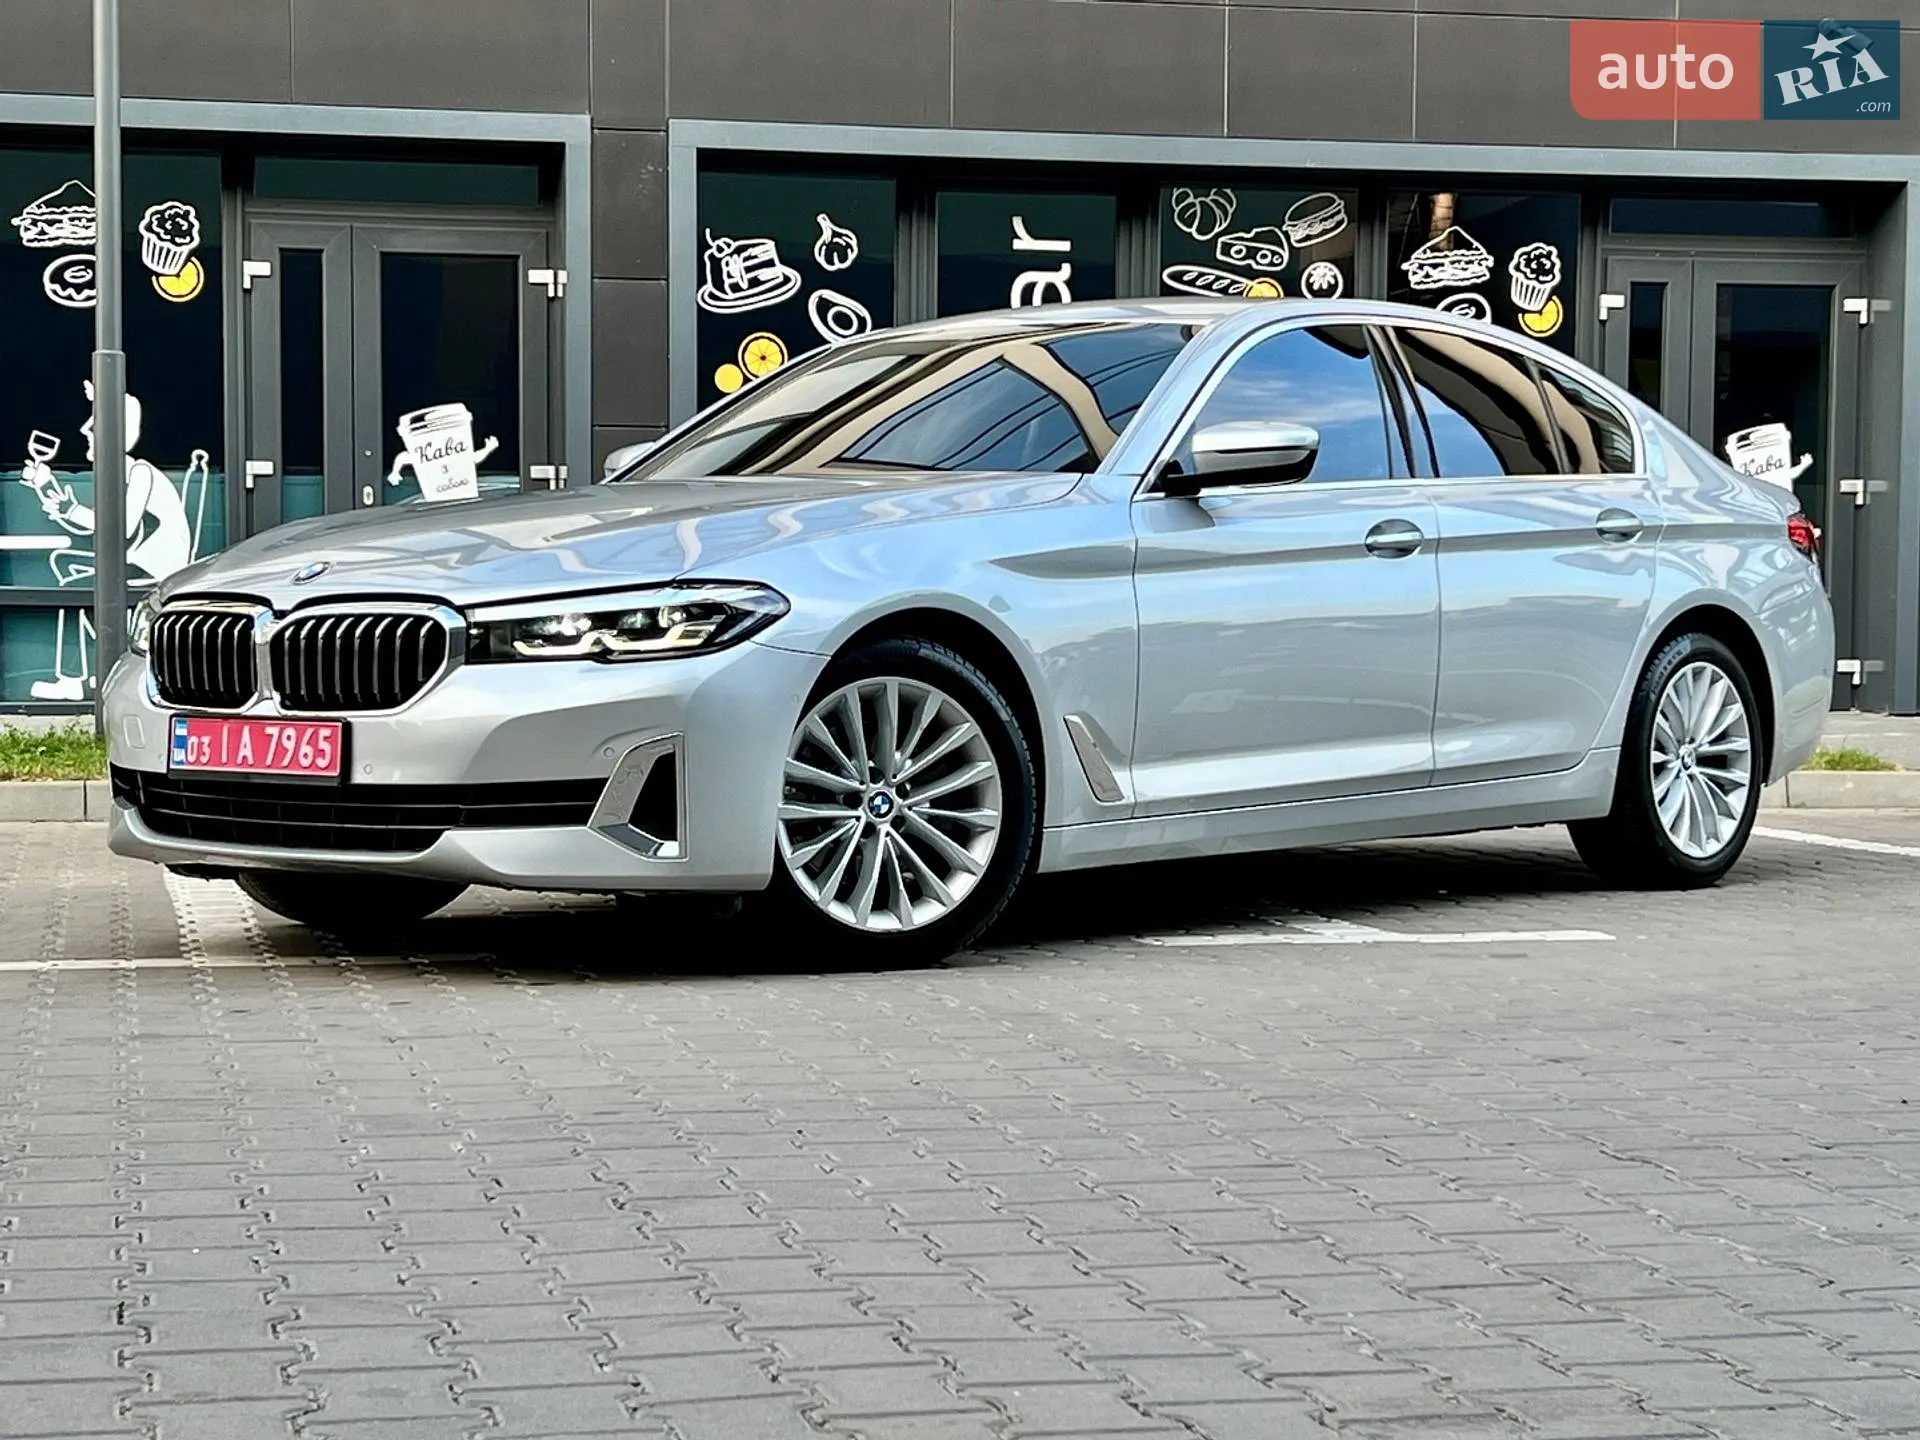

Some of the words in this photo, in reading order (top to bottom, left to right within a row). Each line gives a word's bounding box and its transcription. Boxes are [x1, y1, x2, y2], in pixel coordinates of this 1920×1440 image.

[414, 437, 468, 464] Кава
[187, 735, 212, 764] 03
[264, 726, 333, 769] 7965
